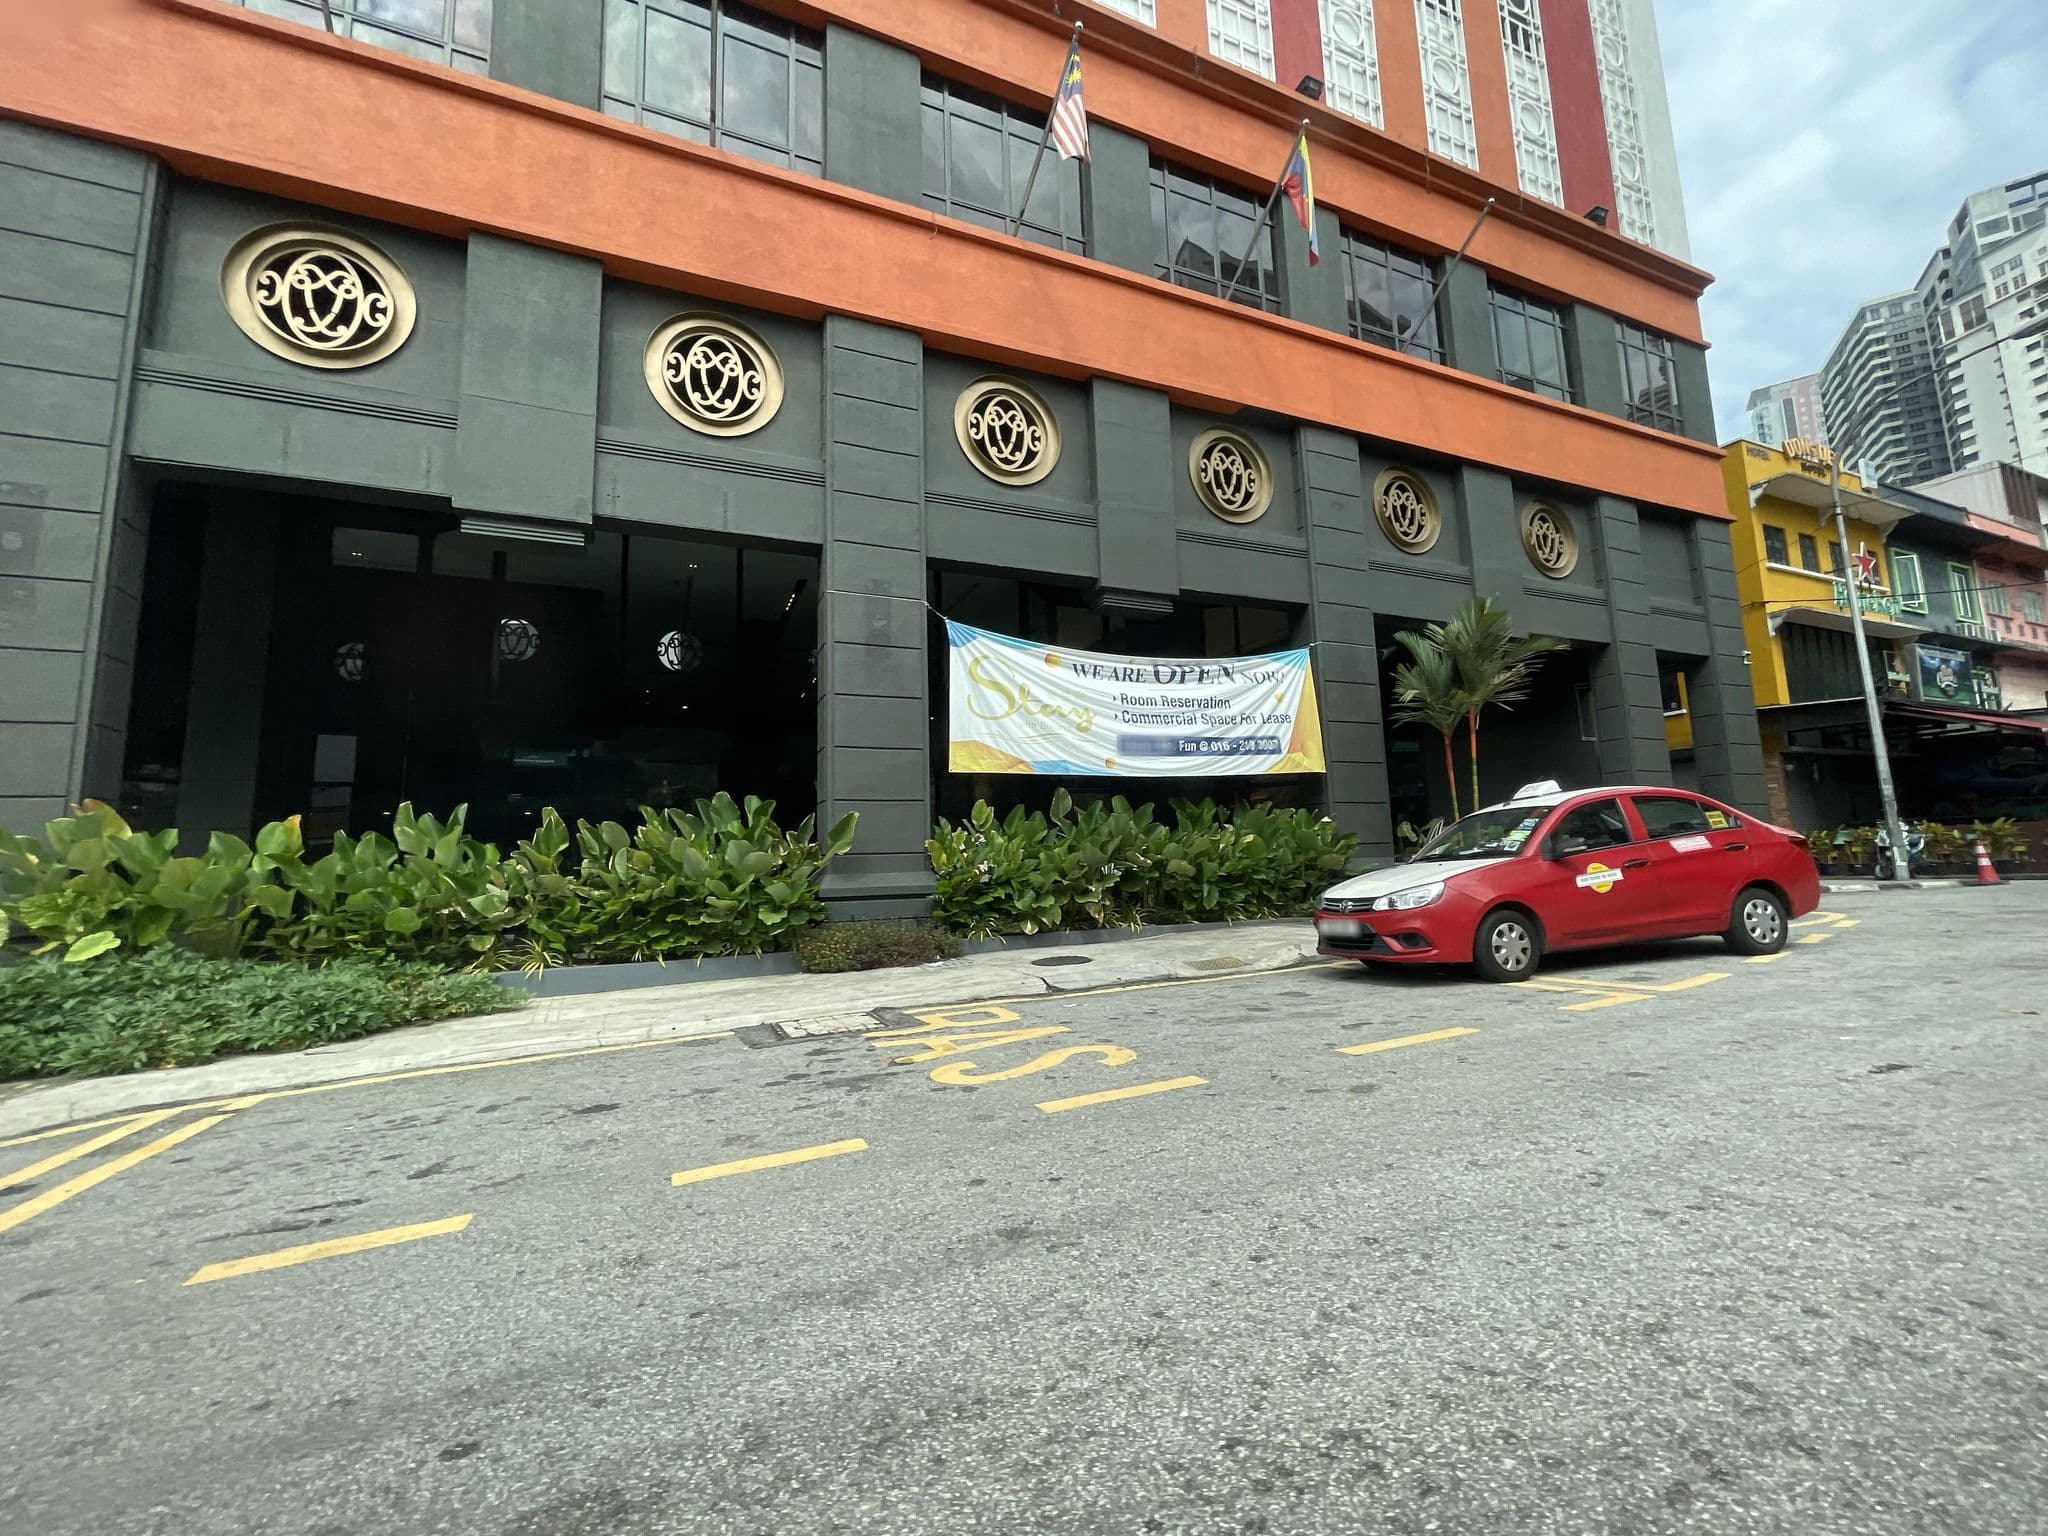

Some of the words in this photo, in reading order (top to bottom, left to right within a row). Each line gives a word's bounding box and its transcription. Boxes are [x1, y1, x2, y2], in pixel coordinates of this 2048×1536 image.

[1072, 663, 1104, 679] WE
[1107, 666, 1147, 683] ARE
[1152, 663, 1238, 685] OPEN
[1120, 693, 1158, 707] Room
[1160, 695, 1231, 709] Reservation
[1122, 710, 1197, 725] Commercial
[1200, 712, 1237, 727] Space
[1240, 712, 1257, 725] For
[1260, 712, 1292, 725] Lease
[1178, 740, 1197, 752] Fun
[1211, 740, 1230, 752] 016
